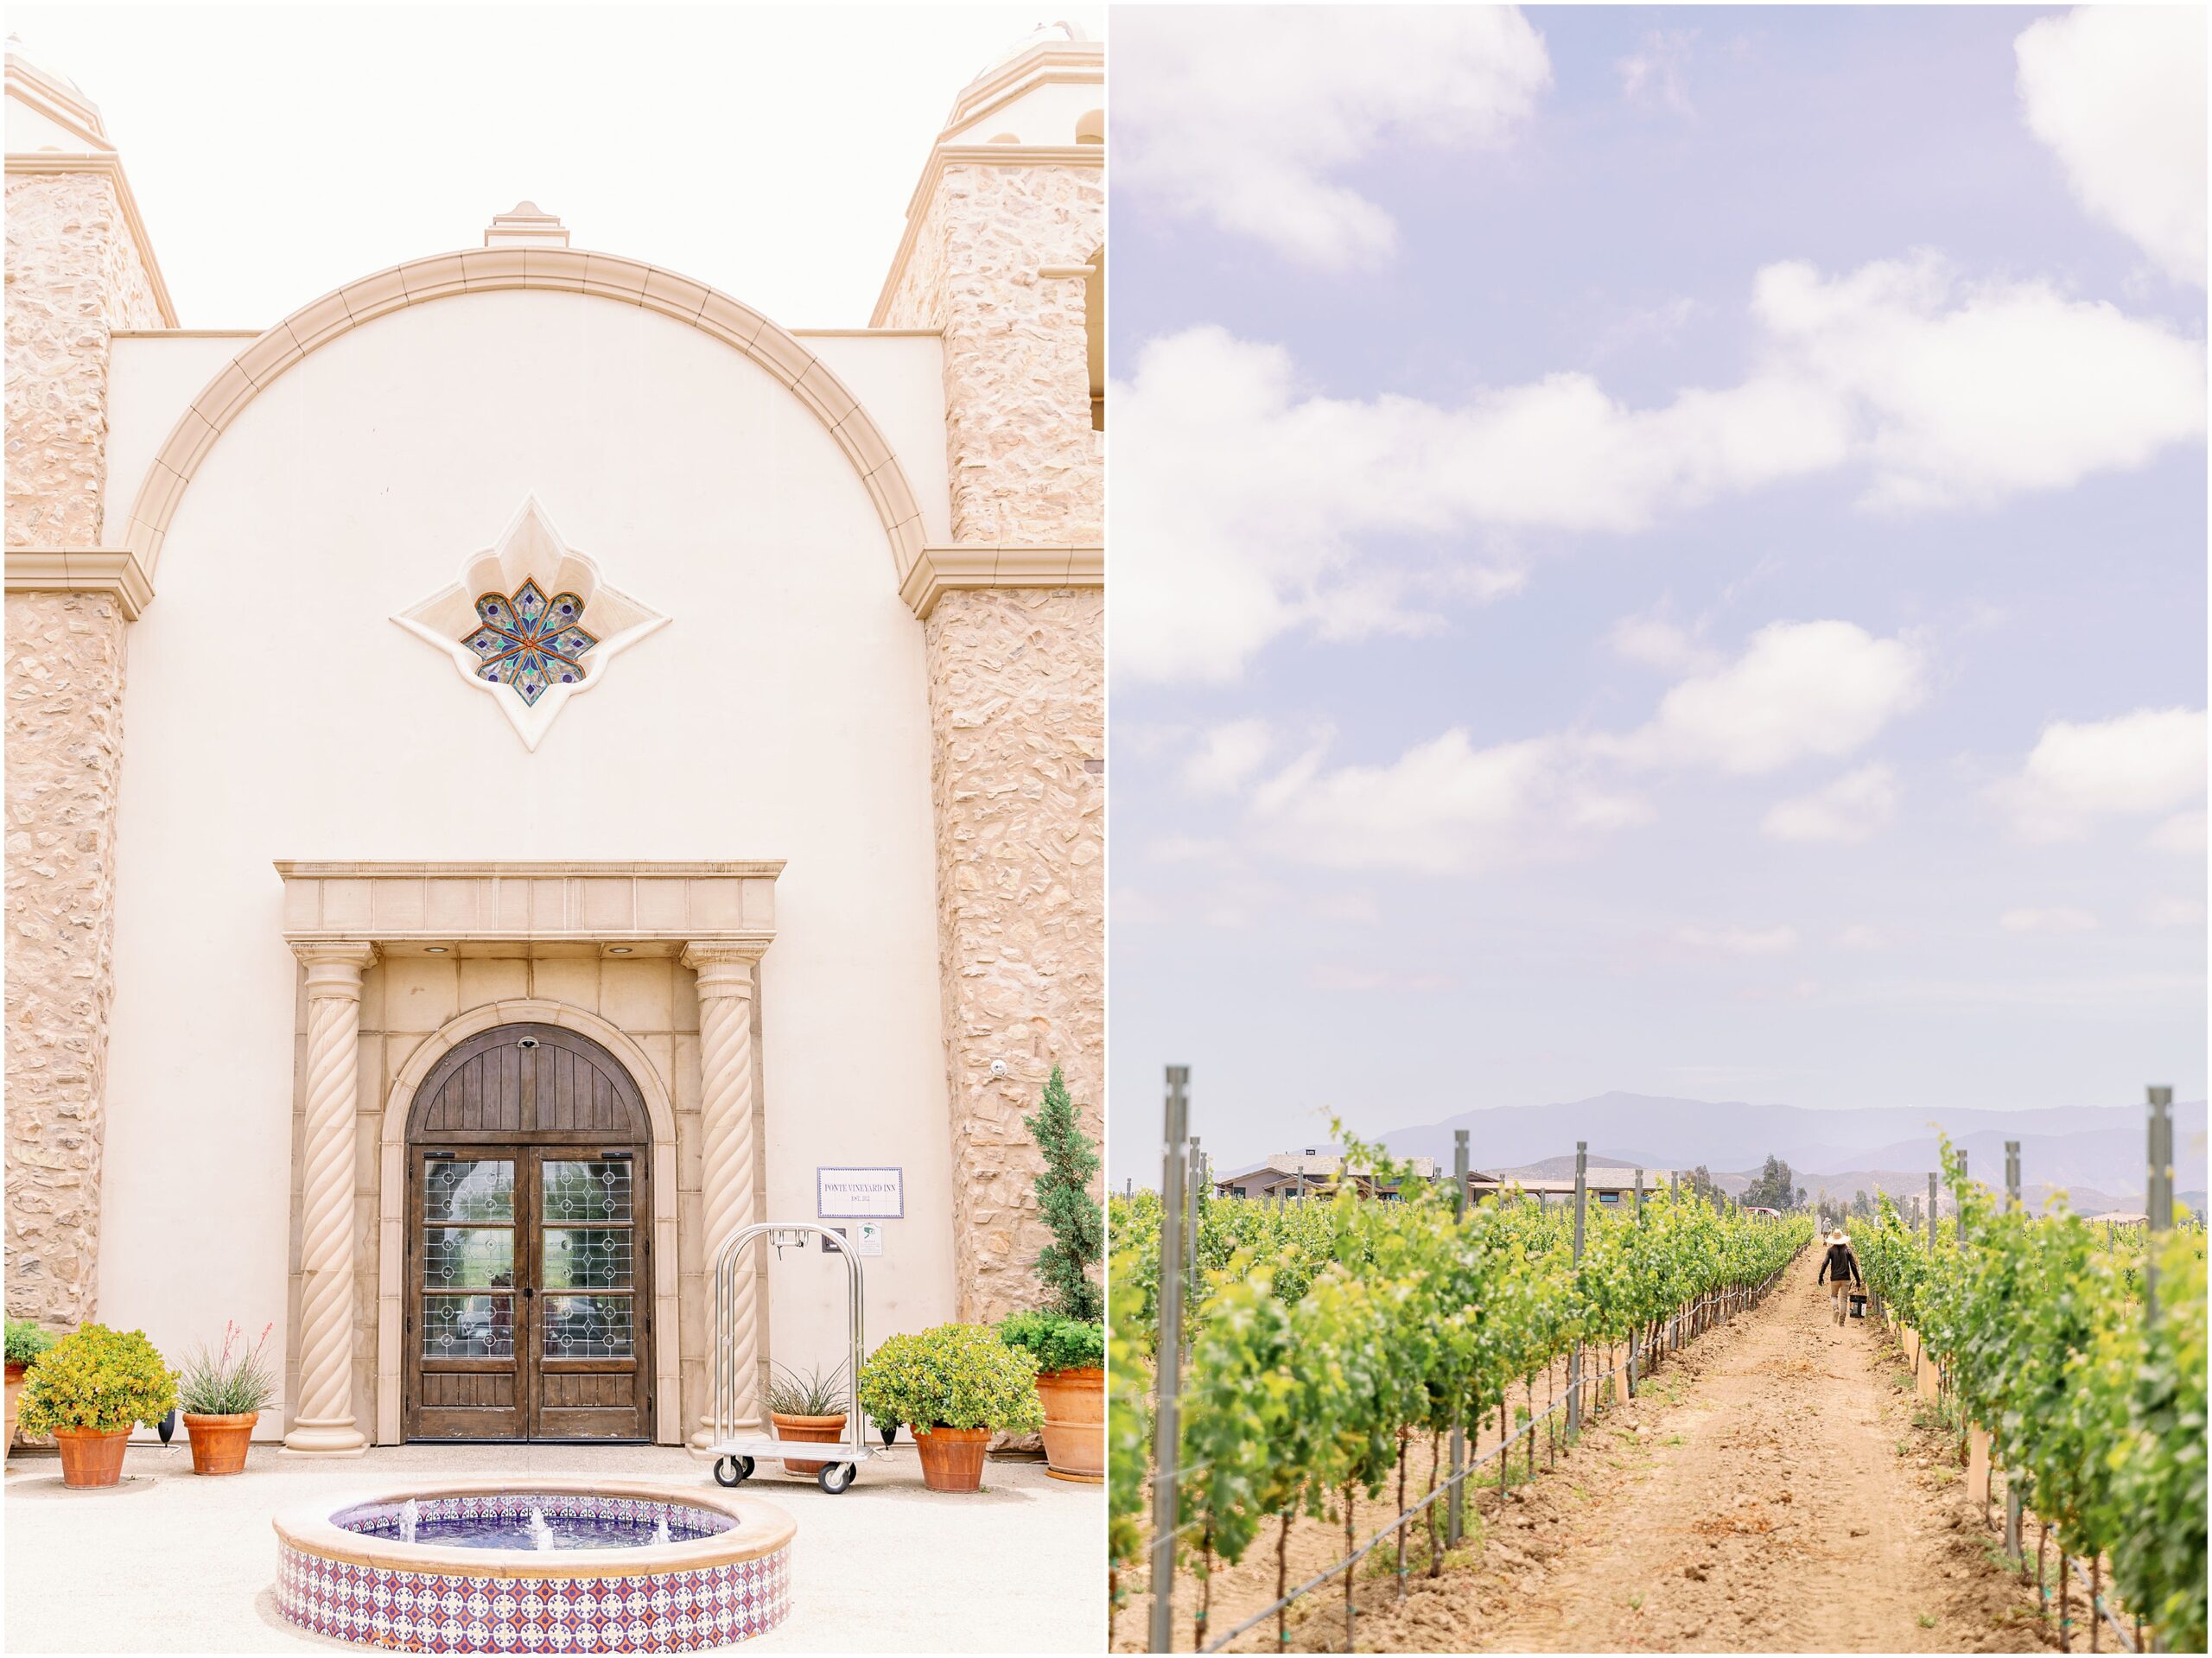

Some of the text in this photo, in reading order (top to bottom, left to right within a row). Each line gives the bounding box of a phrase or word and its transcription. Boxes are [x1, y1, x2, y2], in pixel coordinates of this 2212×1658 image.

[824, 1184, 896, 1192] PONTE VINEYARD INN
